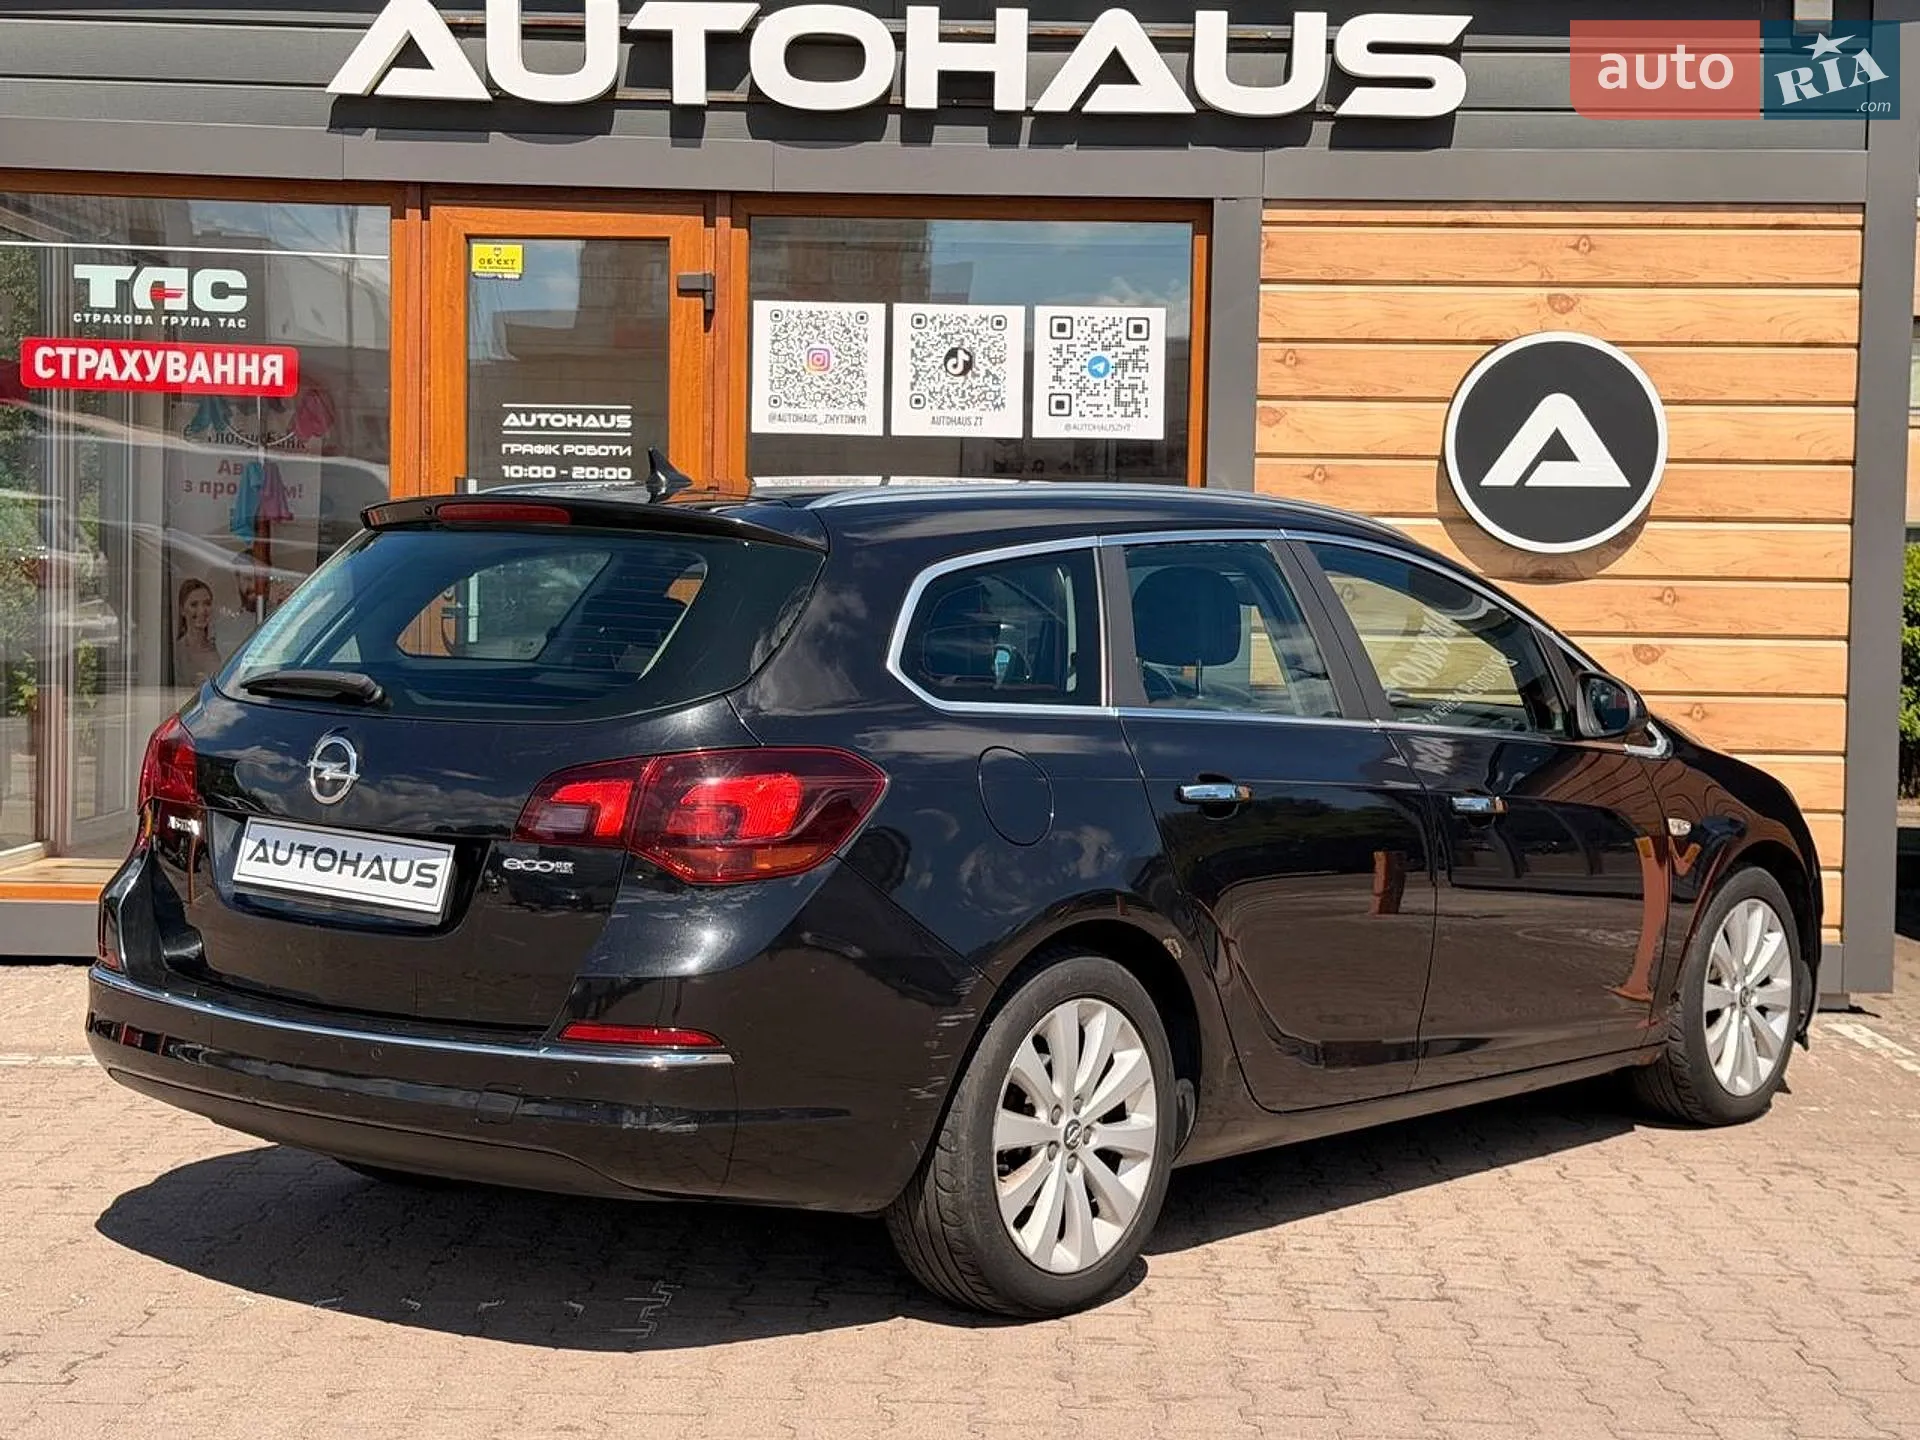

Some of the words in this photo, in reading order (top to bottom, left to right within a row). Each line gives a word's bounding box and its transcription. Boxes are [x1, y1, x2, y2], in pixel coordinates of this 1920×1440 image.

[326, 0, 1473, 118] AUTOHAUS
[74, 264, 248, 313] ТАС
[73, 312, 154, 325] СТРАХОВА
[161, 315, 210, 328] ГРУПА
[218, 317, 247, 329] ТАС
[34, 346, 284, 387] СТРАХУВАННЯ
[502, 412, 633, 429] AUTOHAUS
[931, 415, 972, 427] AUTOHAUS
[973, 416, 984, 427] ZT
[502, 443, 560, 456] ГРАФІК
[562, 444, 632, 457] РОБОТИ
[502, 465, 556, 479] 10:00
[571, 466, 632, 480] 20:00
[246, 836, 444, 890] AUTOHAUS
